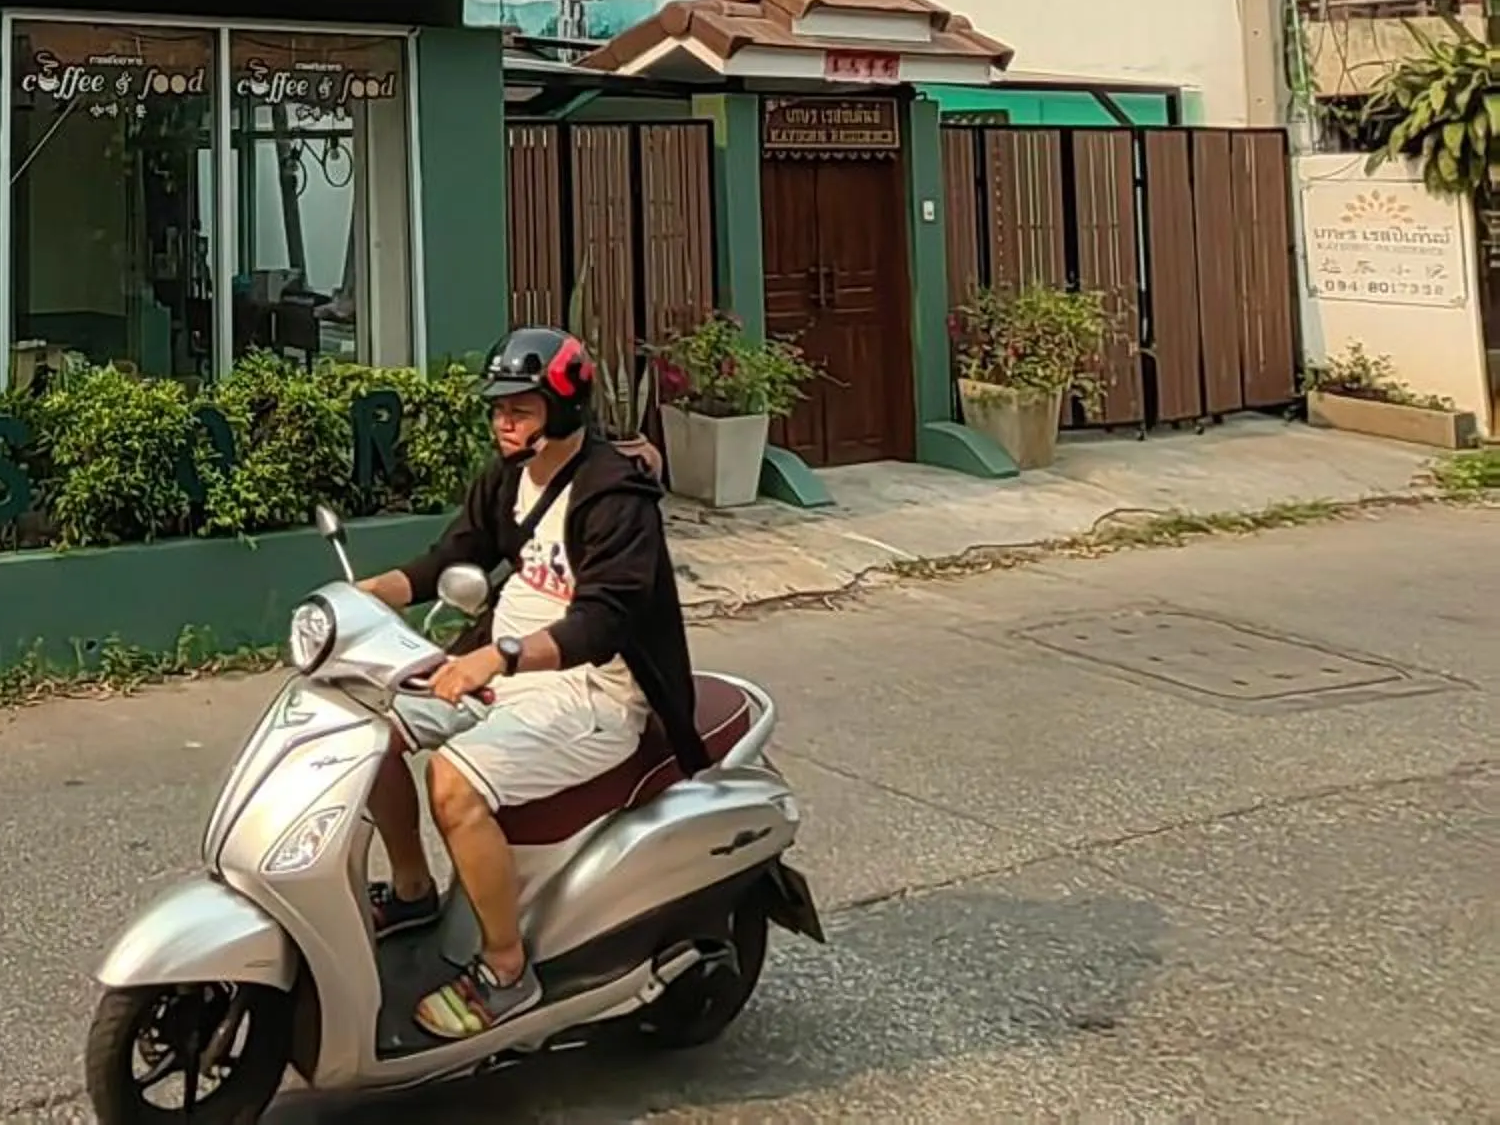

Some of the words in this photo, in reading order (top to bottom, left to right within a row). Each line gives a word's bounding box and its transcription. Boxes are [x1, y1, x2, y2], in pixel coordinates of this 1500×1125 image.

[21, 61, 105, 100] coffee
[115, 71, 133, 96] &
[137, 67, 206, 100] food
[236, 67, 309, 104] coffee
[337, 73, 395, 104] food
